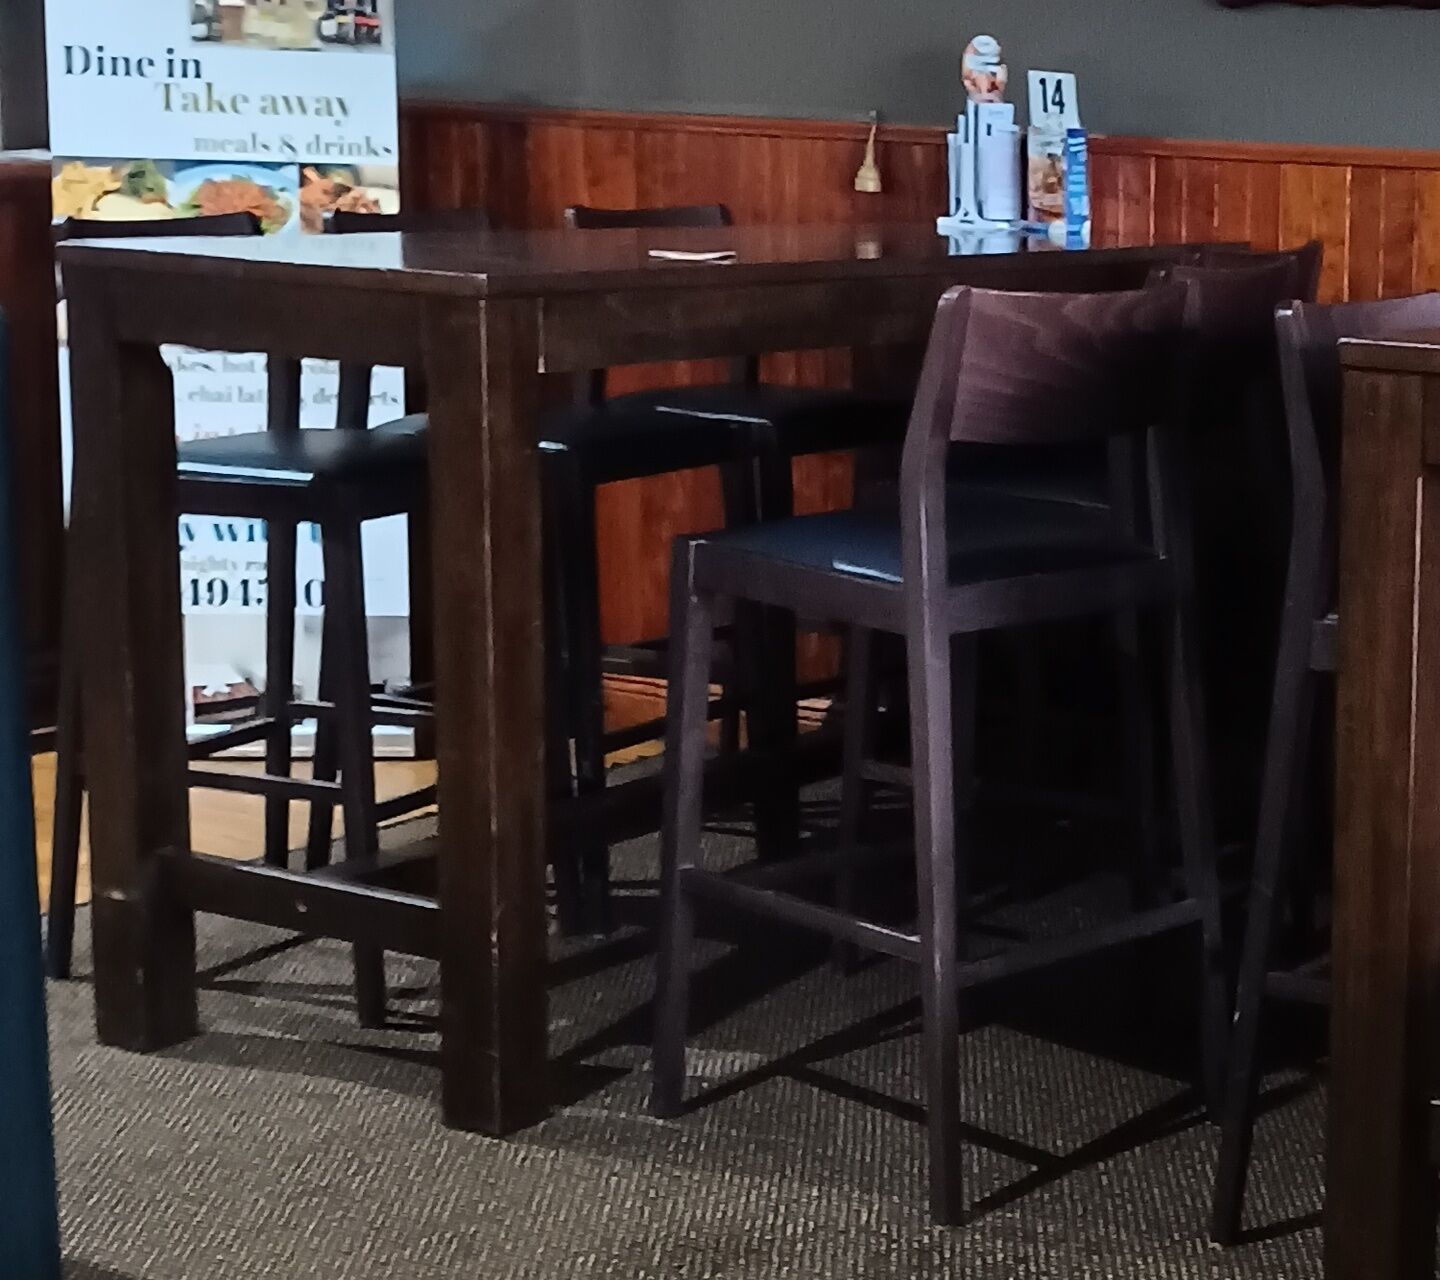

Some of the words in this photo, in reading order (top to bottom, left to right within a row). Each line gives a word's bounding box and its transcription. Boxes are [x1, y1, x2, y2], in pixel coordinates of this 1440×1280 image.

[64, 46, 155, 77] Dine
[166, 48, 202, 79] in
[156, 82, 250, 115] Take
[259, 92, 351, 126] away
[1038, 78, 1065, 114] 14
[194, 133, 271, 153] meals
[306, 134, 392, 157] drinks
